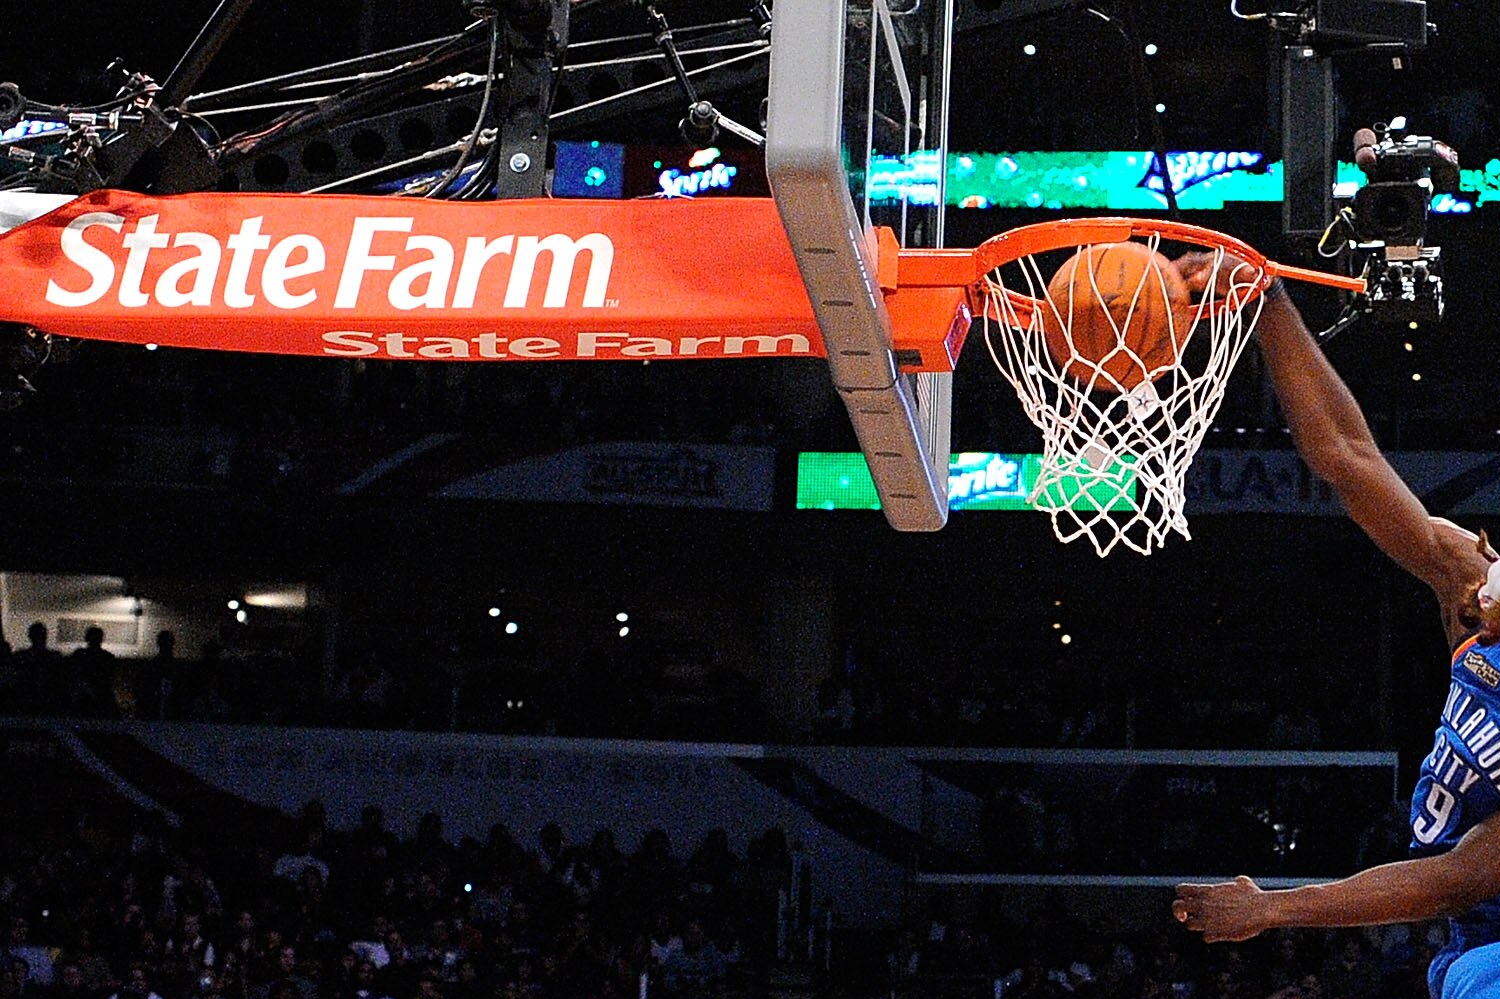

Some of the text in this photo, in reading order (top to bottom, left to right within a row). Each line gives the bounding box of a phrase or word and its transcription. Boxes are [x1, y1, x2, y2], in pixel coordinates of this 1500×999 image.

[45, 211, 328, 310] State
[333, 215, 616, 309] Farm
[321, 330, 812, 359] State Farm
[1429, 734, 1481, 793] CITY
[1413, 783, 1455, 844] 9
